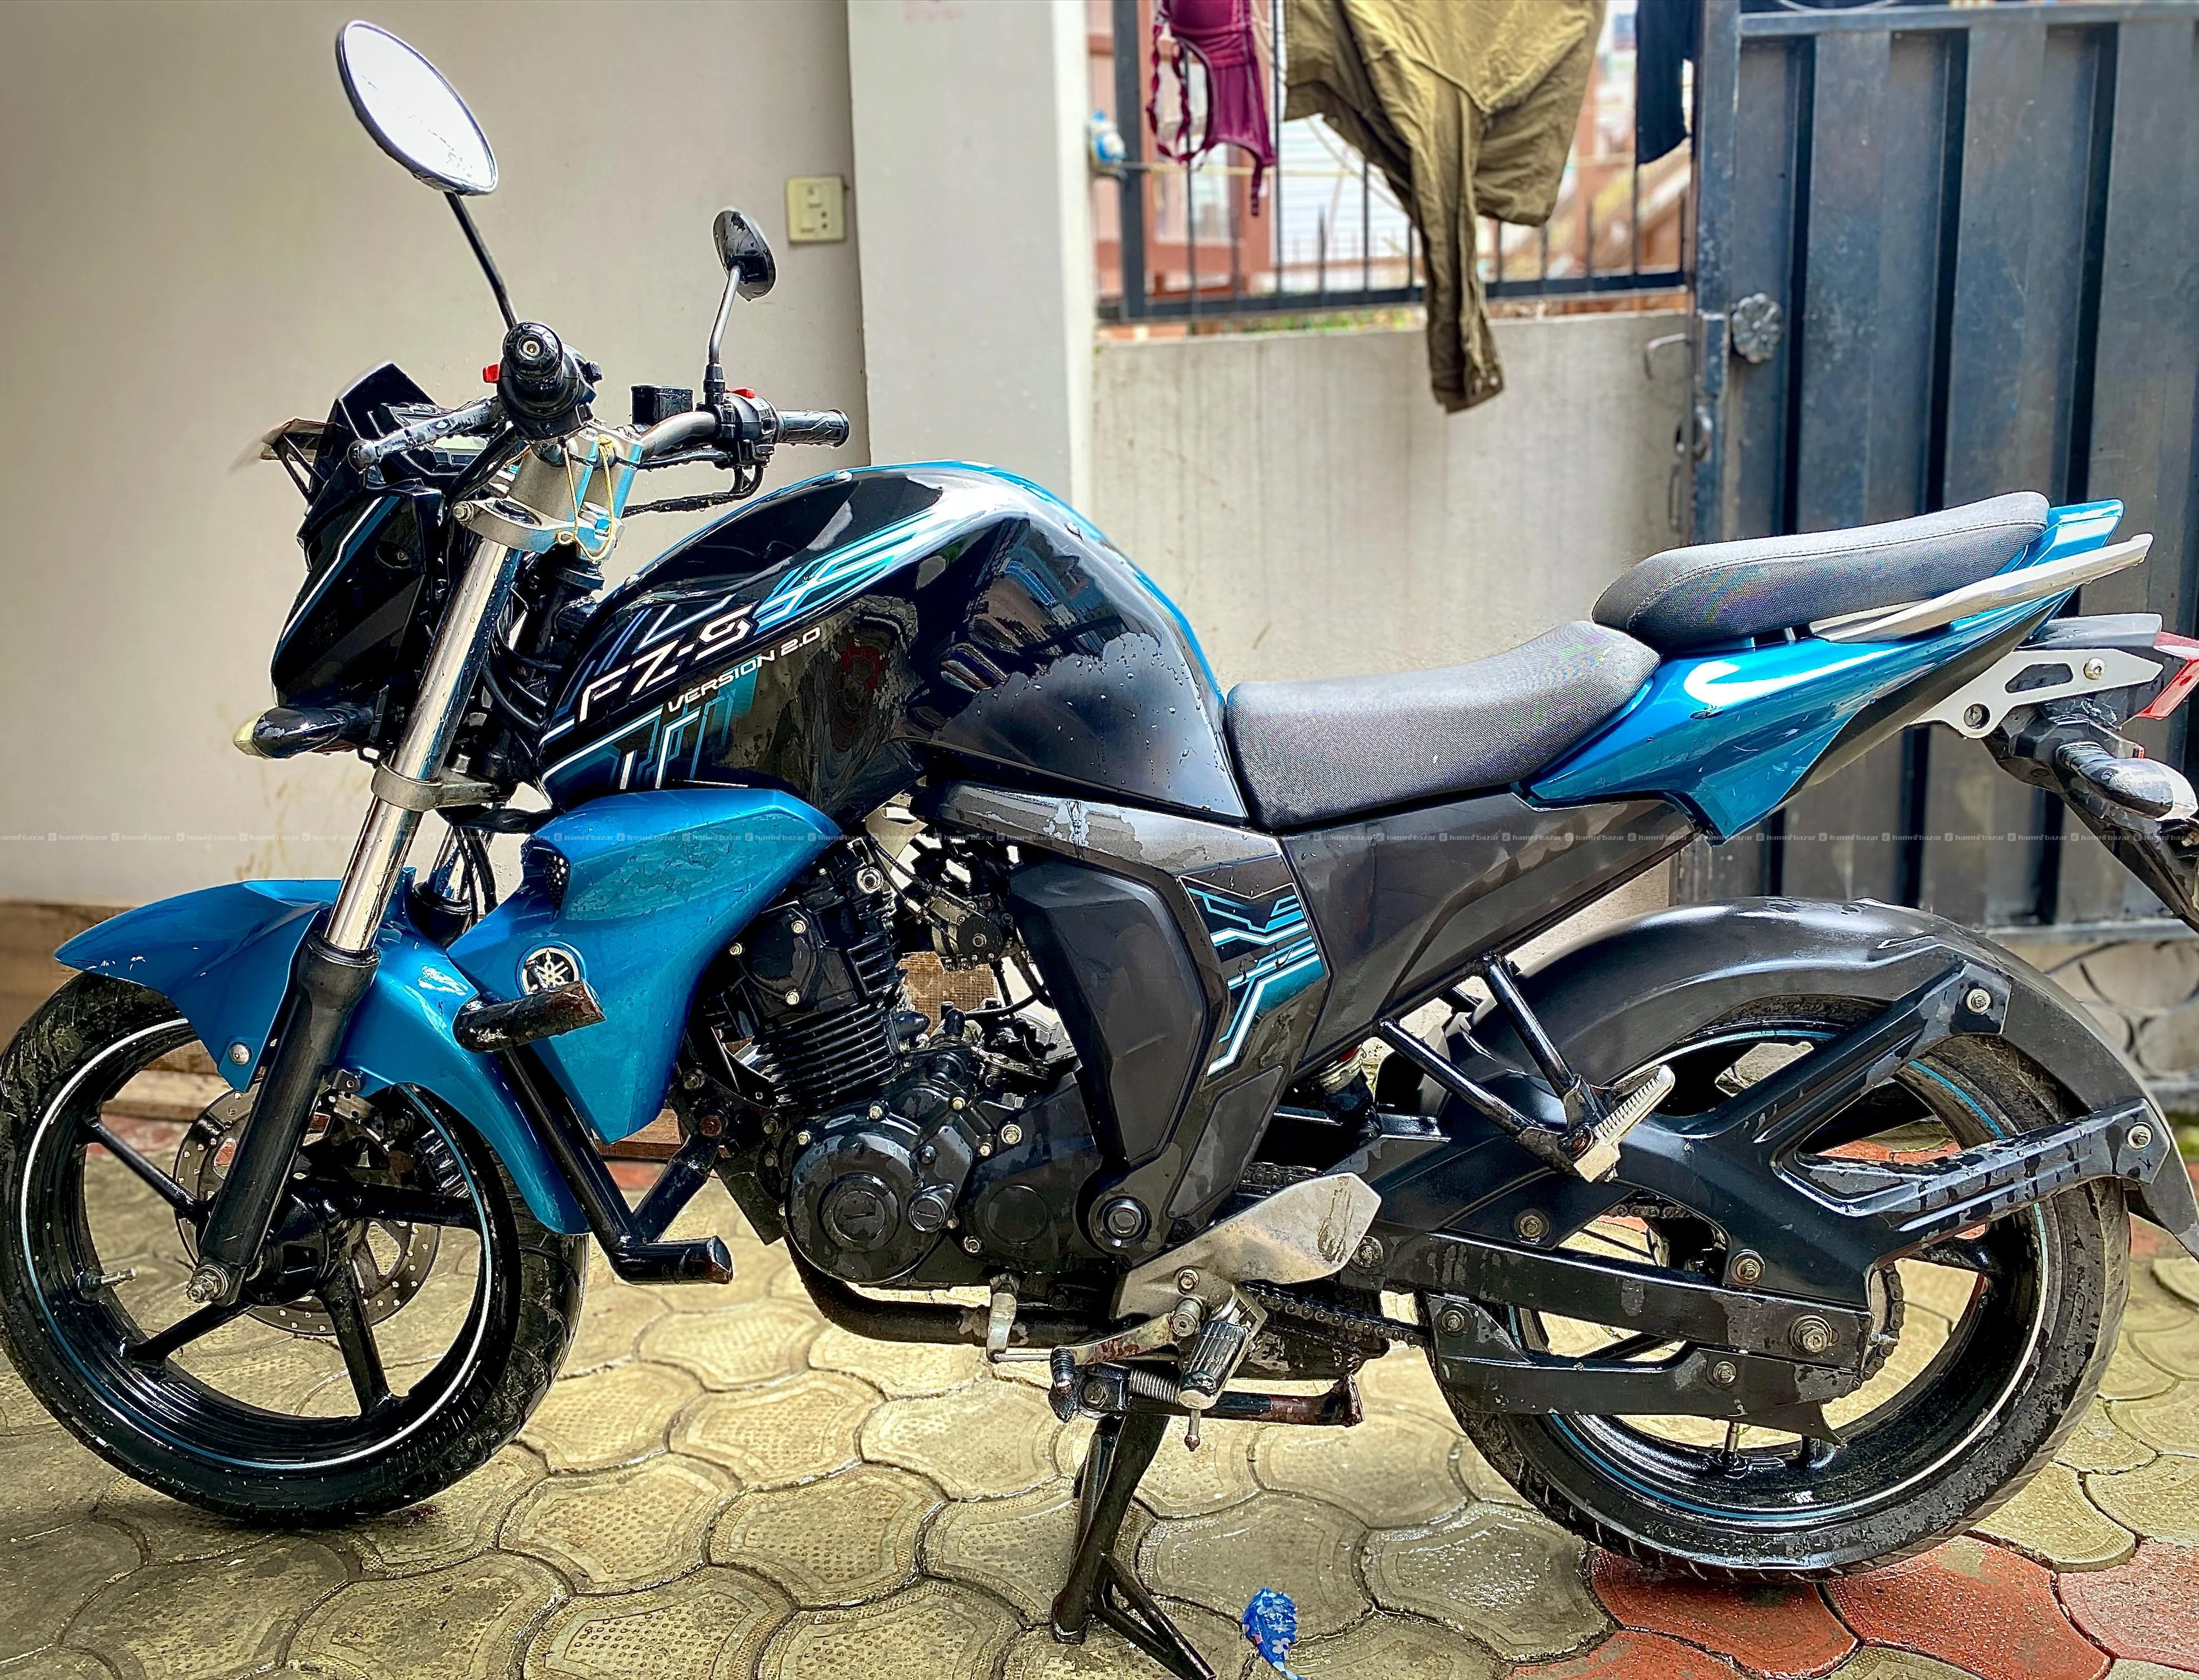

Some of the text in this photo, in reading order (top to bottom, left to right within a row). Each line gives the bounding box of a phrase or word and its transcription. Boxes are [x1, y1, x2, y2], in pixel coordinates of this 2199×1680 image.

[578, 602, 758, 722] FZ-S
[668, 627, 821, 712] VERSION 2.0
